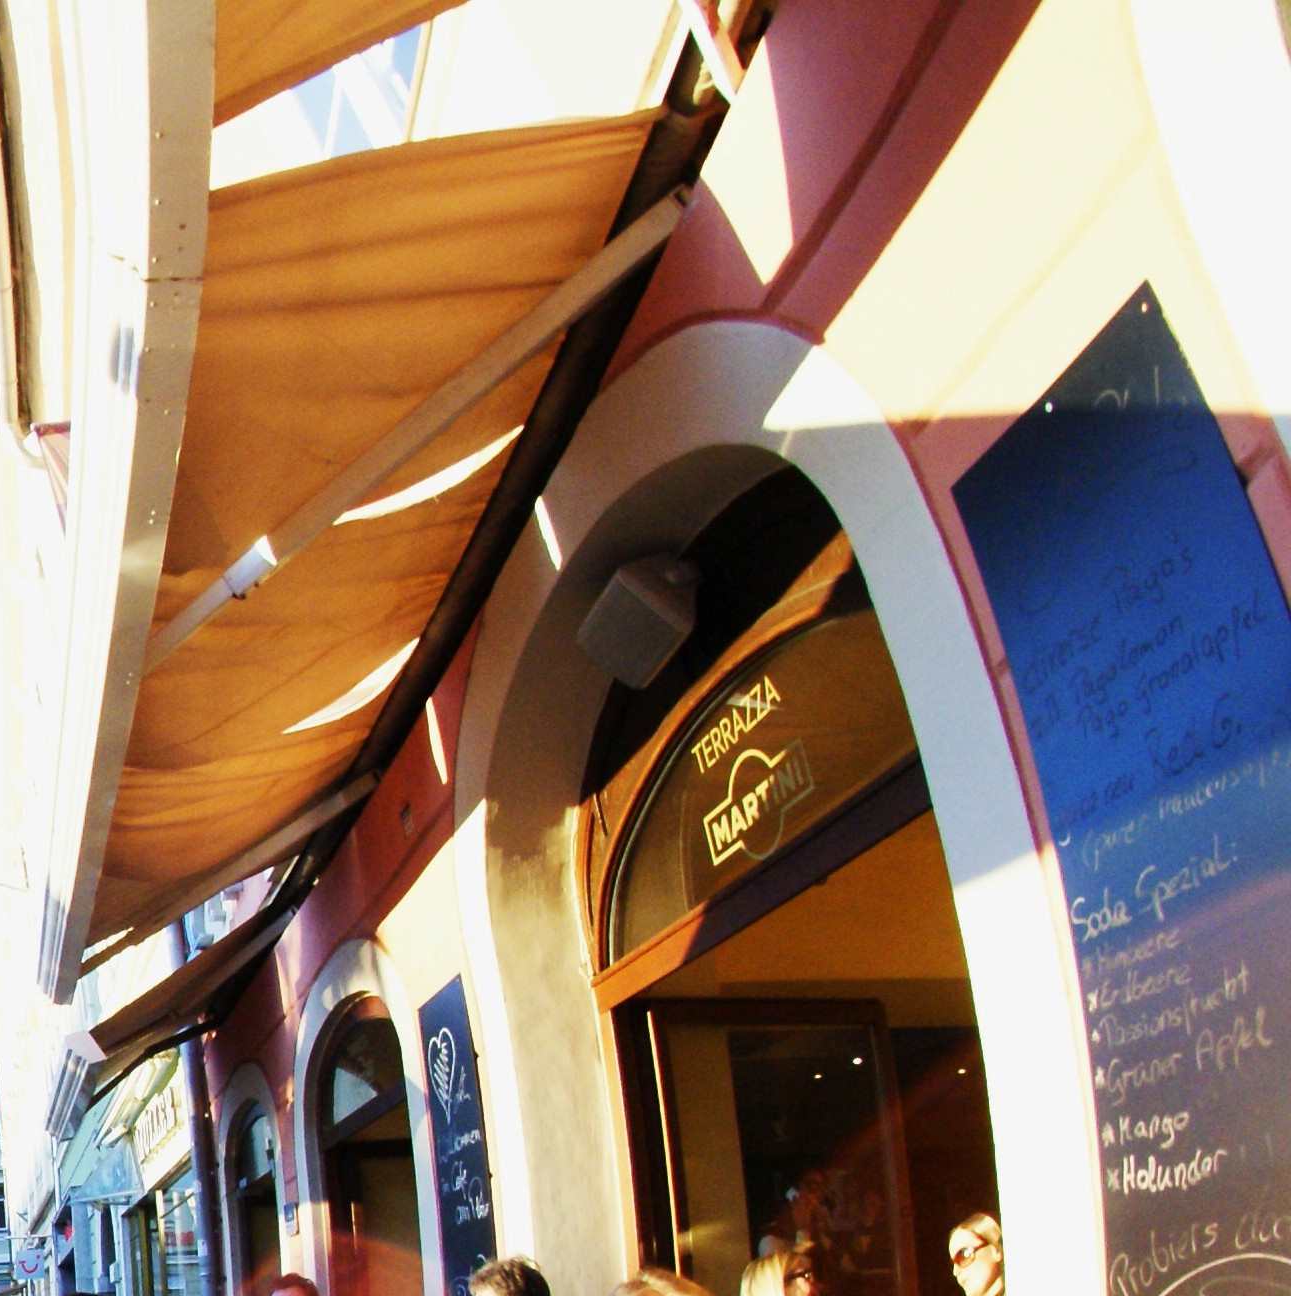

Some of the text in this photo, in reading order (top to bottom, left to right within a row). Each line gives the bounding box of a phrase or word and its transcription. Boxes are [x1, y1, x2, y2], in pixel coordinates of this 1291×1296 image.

[691, 675, 781, 774] TERRAZZA
[710, 760, 805, 851] MARTINI
[1070, 887, 1132, 943] Soda
[1119, 1111, 1189, 1149] Mango
[1122, 1149, 1227, 1195] Holunder
